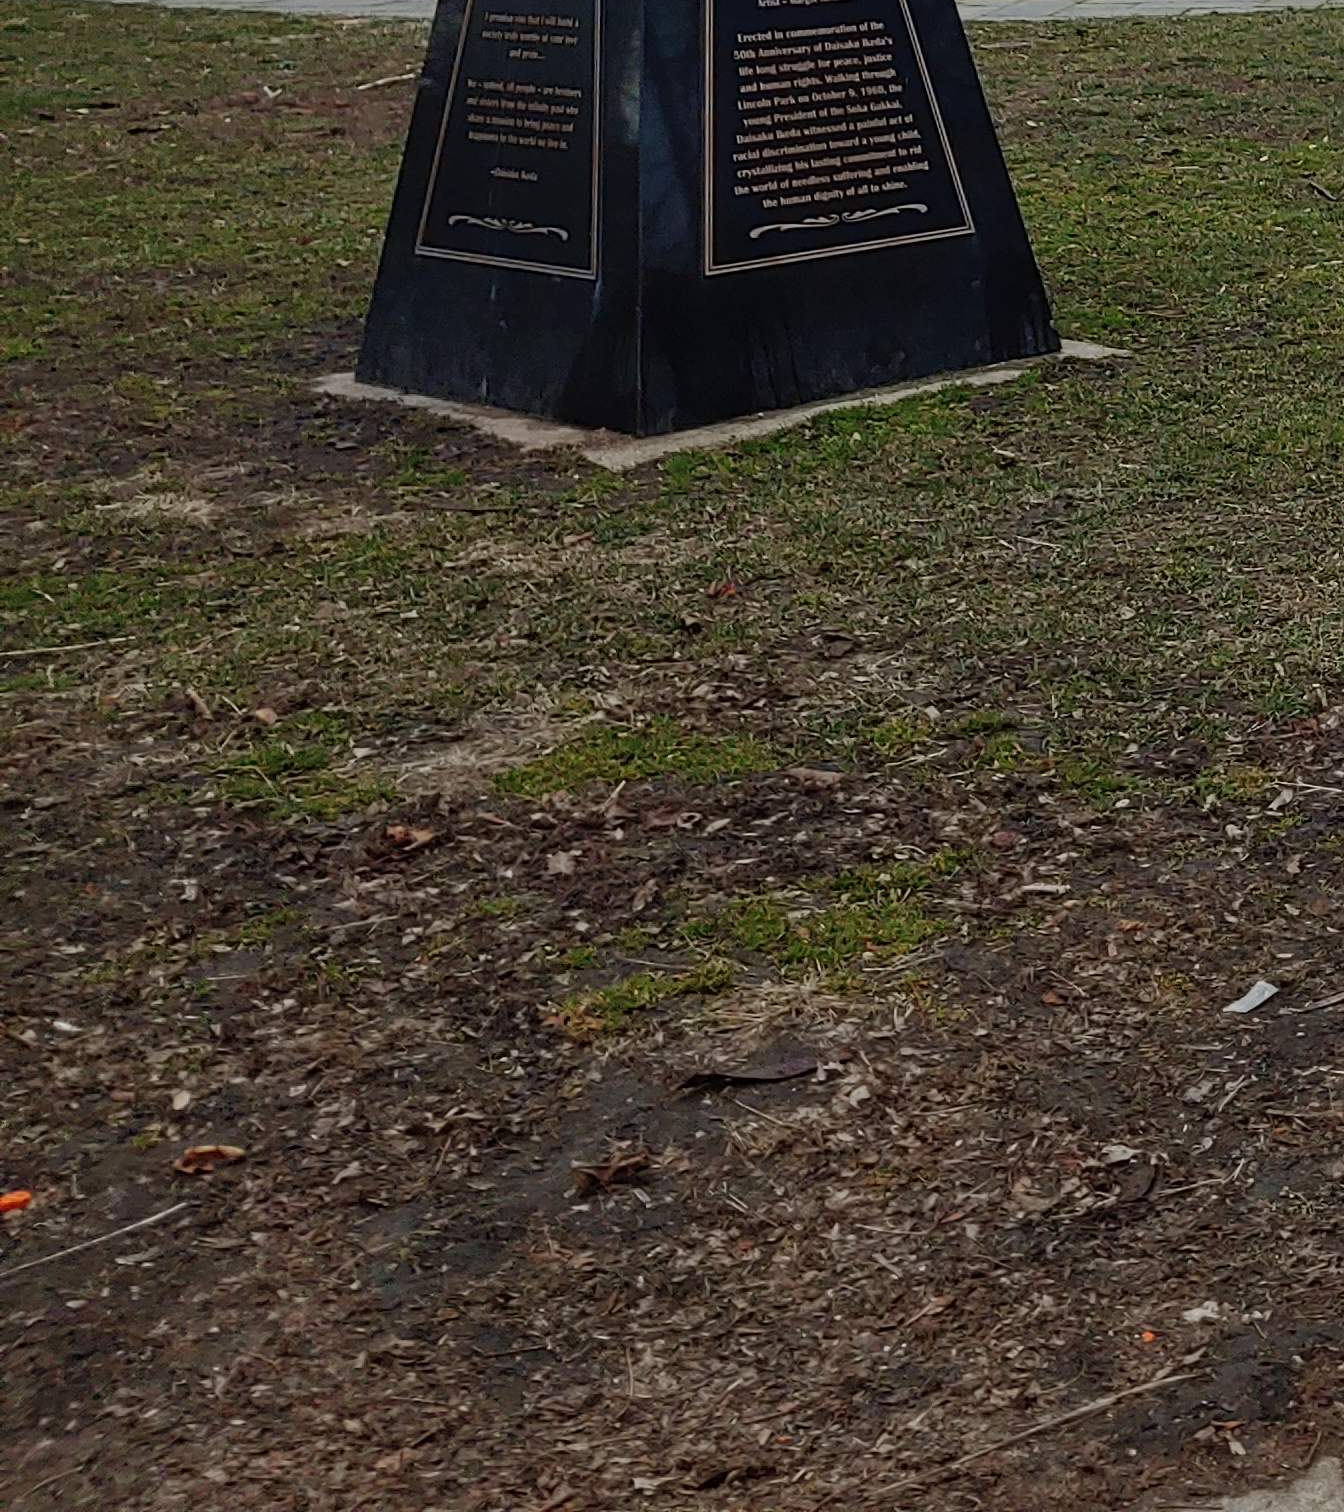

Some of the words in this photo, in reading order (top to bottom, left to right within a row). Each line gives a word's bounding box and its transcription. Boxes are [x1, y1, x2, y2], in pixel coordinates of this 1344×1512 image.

[737, 31, 773, 43] Erected
[774, 31, 784, 40] in
[786, 25, 857, 39] commemoration
[859, 22, 868, 31] of
[870, 22, 884, 31] the
[734, 50, 756, 60] 50th
[759, 46, 811, 57] Anniversary
[813, 43, 822, 52] of
[824, 40, 860, 51] Daisaku
[739, 67, 754, 76] life
[756, 64, 777, 75] long
[818, 60, 831, 68] for
[864, 54, 892, 65] justice
[740, 82, 758, 93] and
[759, 81, 792, 91] human
[825, 72, 861, 83] Walking
[862, 68, 897, 79] through
[738, 98, 772, 111] Lincoln
[774, 96, 796, 106] Park
[812, 91, 846, 101] October
[889, 84, 903, 93] the
[743, 115, 772, 127] young
[774, 110, 817, 123] President
[819, 108, 828, 117] of
[830, 107, 844, 116] the
[846, 104, 868, 113] Soka
[736, 132, 774, 144] Daisaku
[776, 128, 801, 139] Ikeda
[803, 122, 847, 135] witnessed
[889, 116, 902, 125] act
[904, 114, 913, 123] of
[733, 150, 760, 162] racial
[762, 143, 827, 158] discrimination
[795, 161, 809, 170] his
[810, 157, 842, 168] lasting
[898, 148, 908, 156] to
[909, 145, 922, 155] rid
[734, 186, 750, 196] the
[752, 181, 778, 192] world
[780, 179, 789, 189] of
[792, 176, 831, 187] needless
[874, 166, 891, 176] and
[763, 199, 778, 208] the
[780, 195, 812, 206] human
[846, 187, 855, 196] of
[870, 184, 880, 193] to
